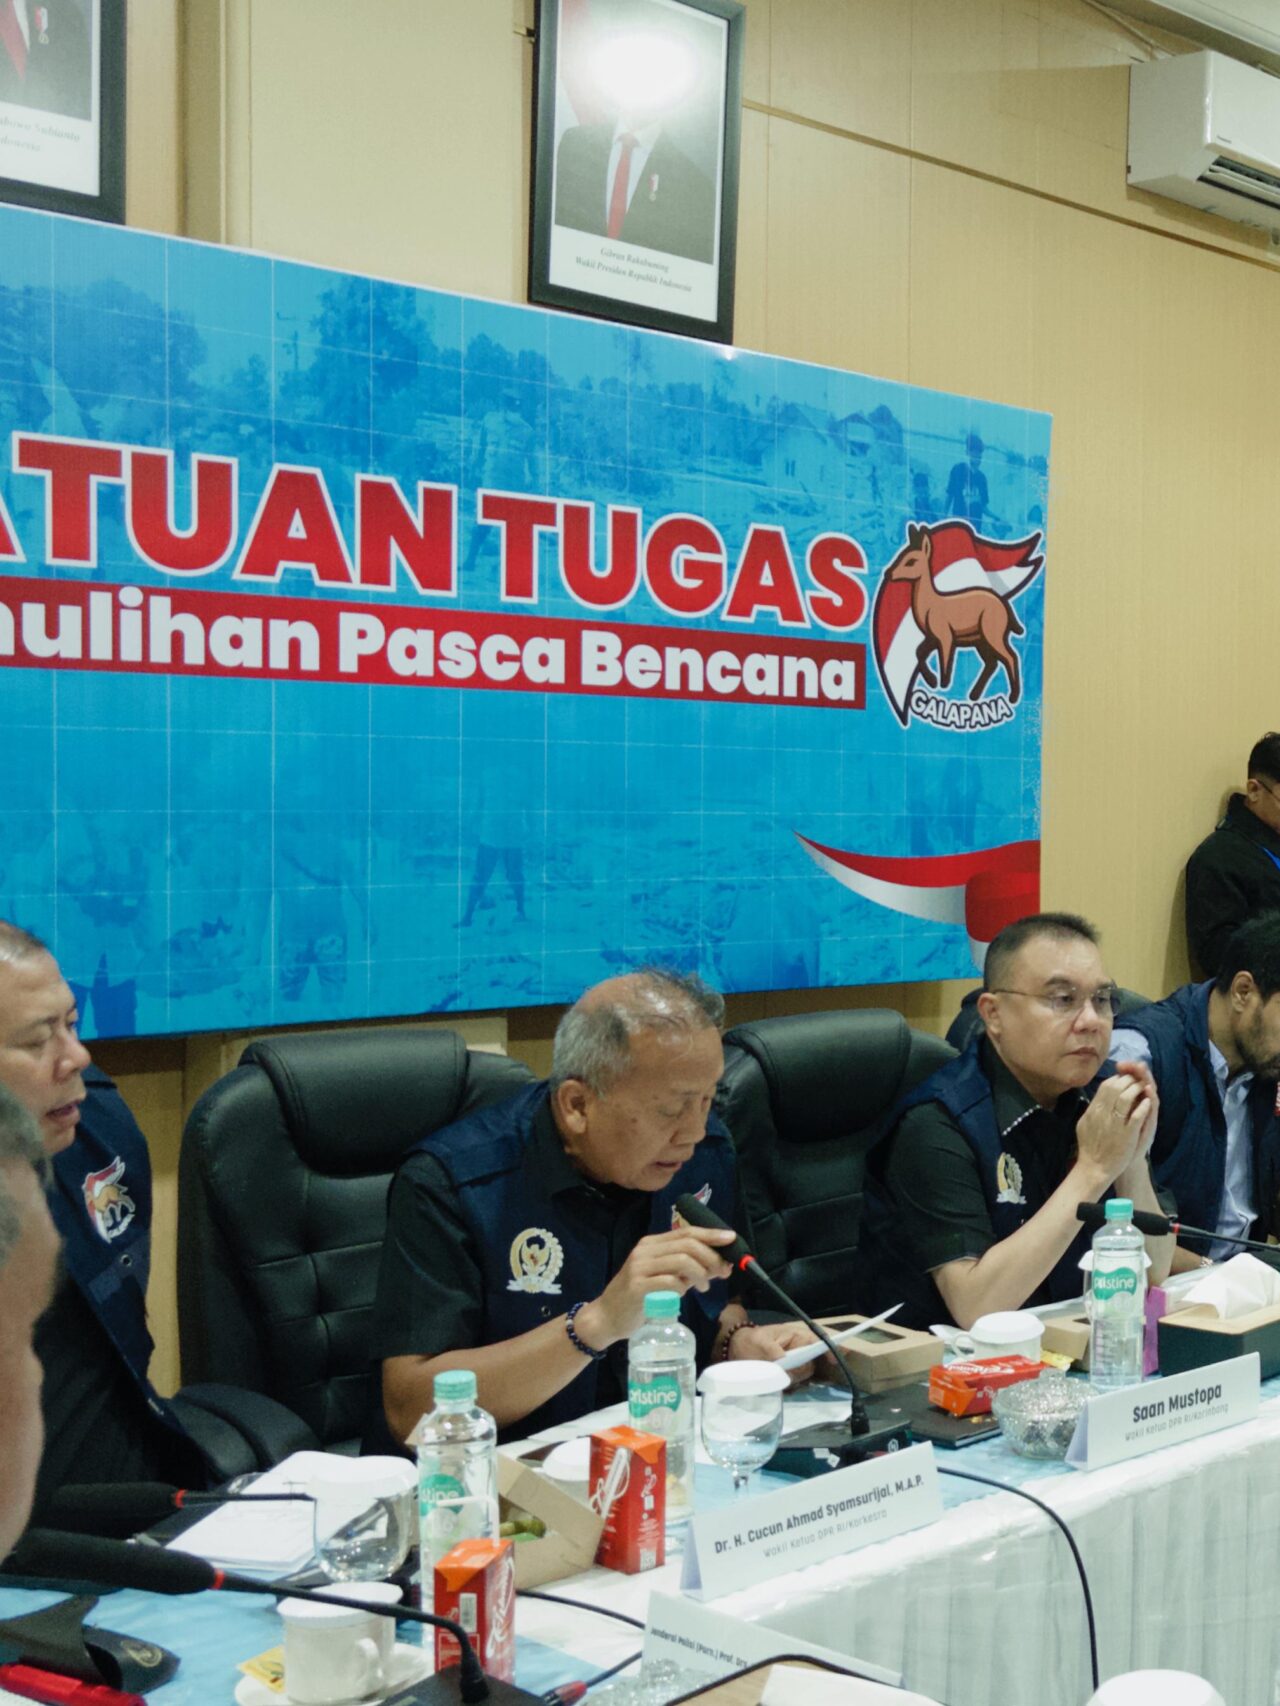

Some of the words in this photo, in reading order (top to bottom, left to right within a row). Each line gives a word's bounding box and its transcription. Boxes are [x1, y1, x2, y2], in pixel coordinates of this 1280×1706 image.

[0, 430, 459, 598] TUAN
[477, 488, 869, 633] TUGAS
[0, 585, 320, 672] ulihan
[339, 611, 566, 684] Pasca
[580, 629, 856, 701] Bencana
[909, 689, 1013, 729] GALAPANA
[1133, 1401, 1165, 1423] Saan
[1168, 1384, 1222, 1412] Mustopa
[715, 1540, 732, 1554] Dr.
[734, 1533, 746, 1547] H.
[747, 1522, 783, 1543] Cucun
[786, 1505, 824, 1530] Ahmad
[895, 1474, 924, 1493] M.A.P.
